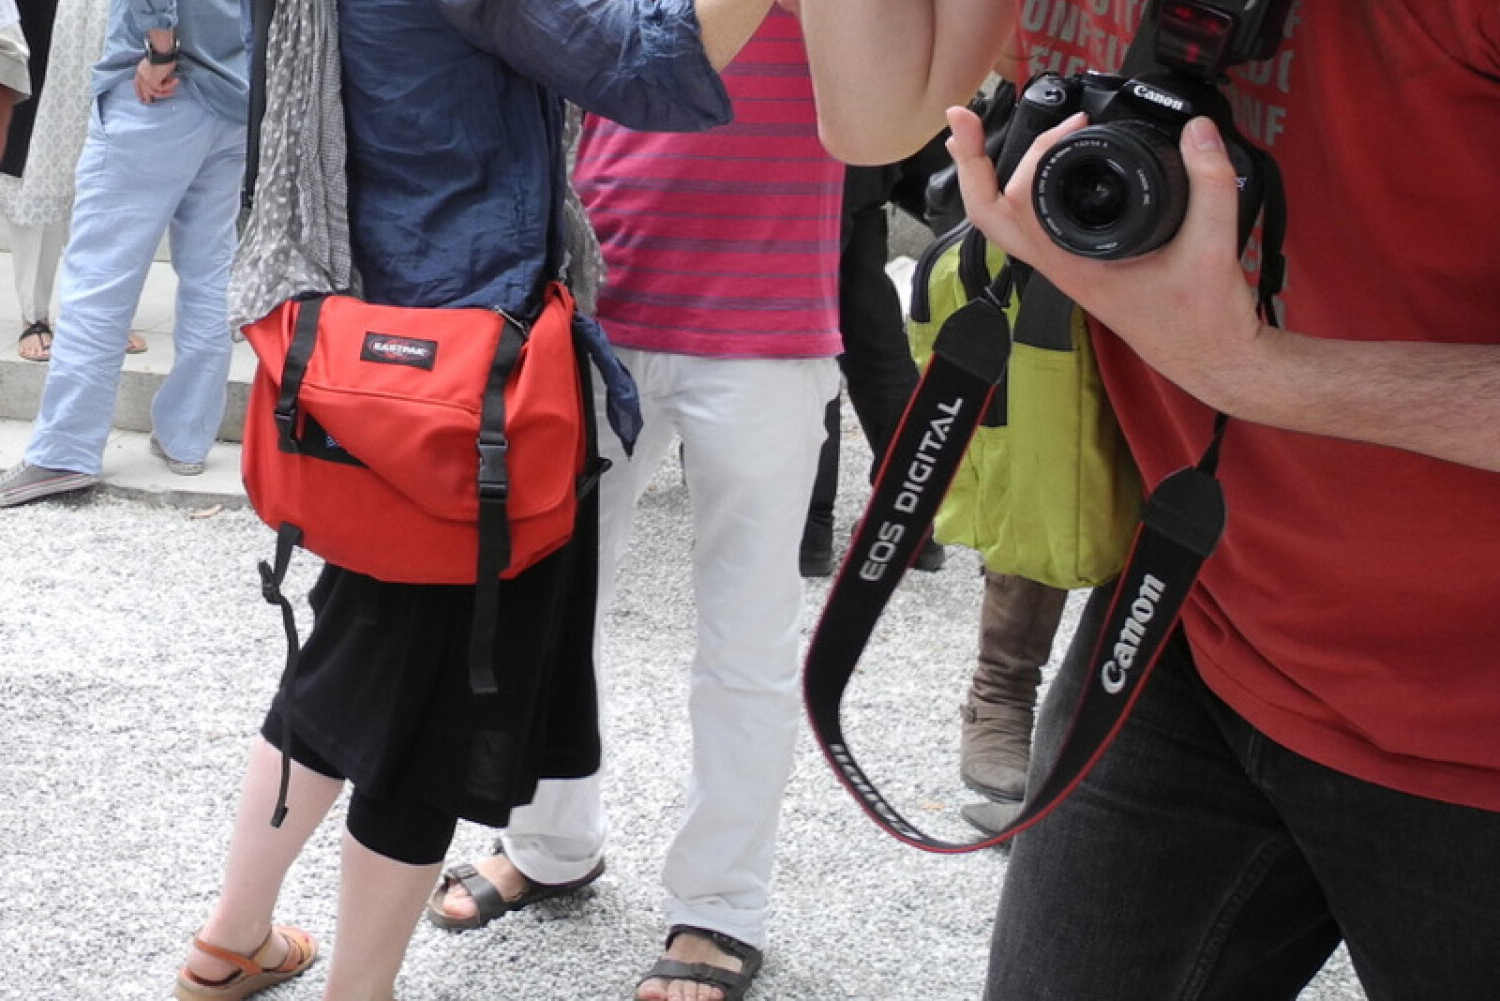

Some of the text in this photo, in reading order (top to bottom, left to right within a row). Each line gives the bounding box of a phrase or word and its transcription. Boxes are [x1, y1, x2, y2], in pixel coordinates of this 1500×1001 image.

[1133, 85, 1184, 111] Canon
[859, 397, 964, 582] EOS DIGITAL
[1101, 573, 1166, 694] Canon
